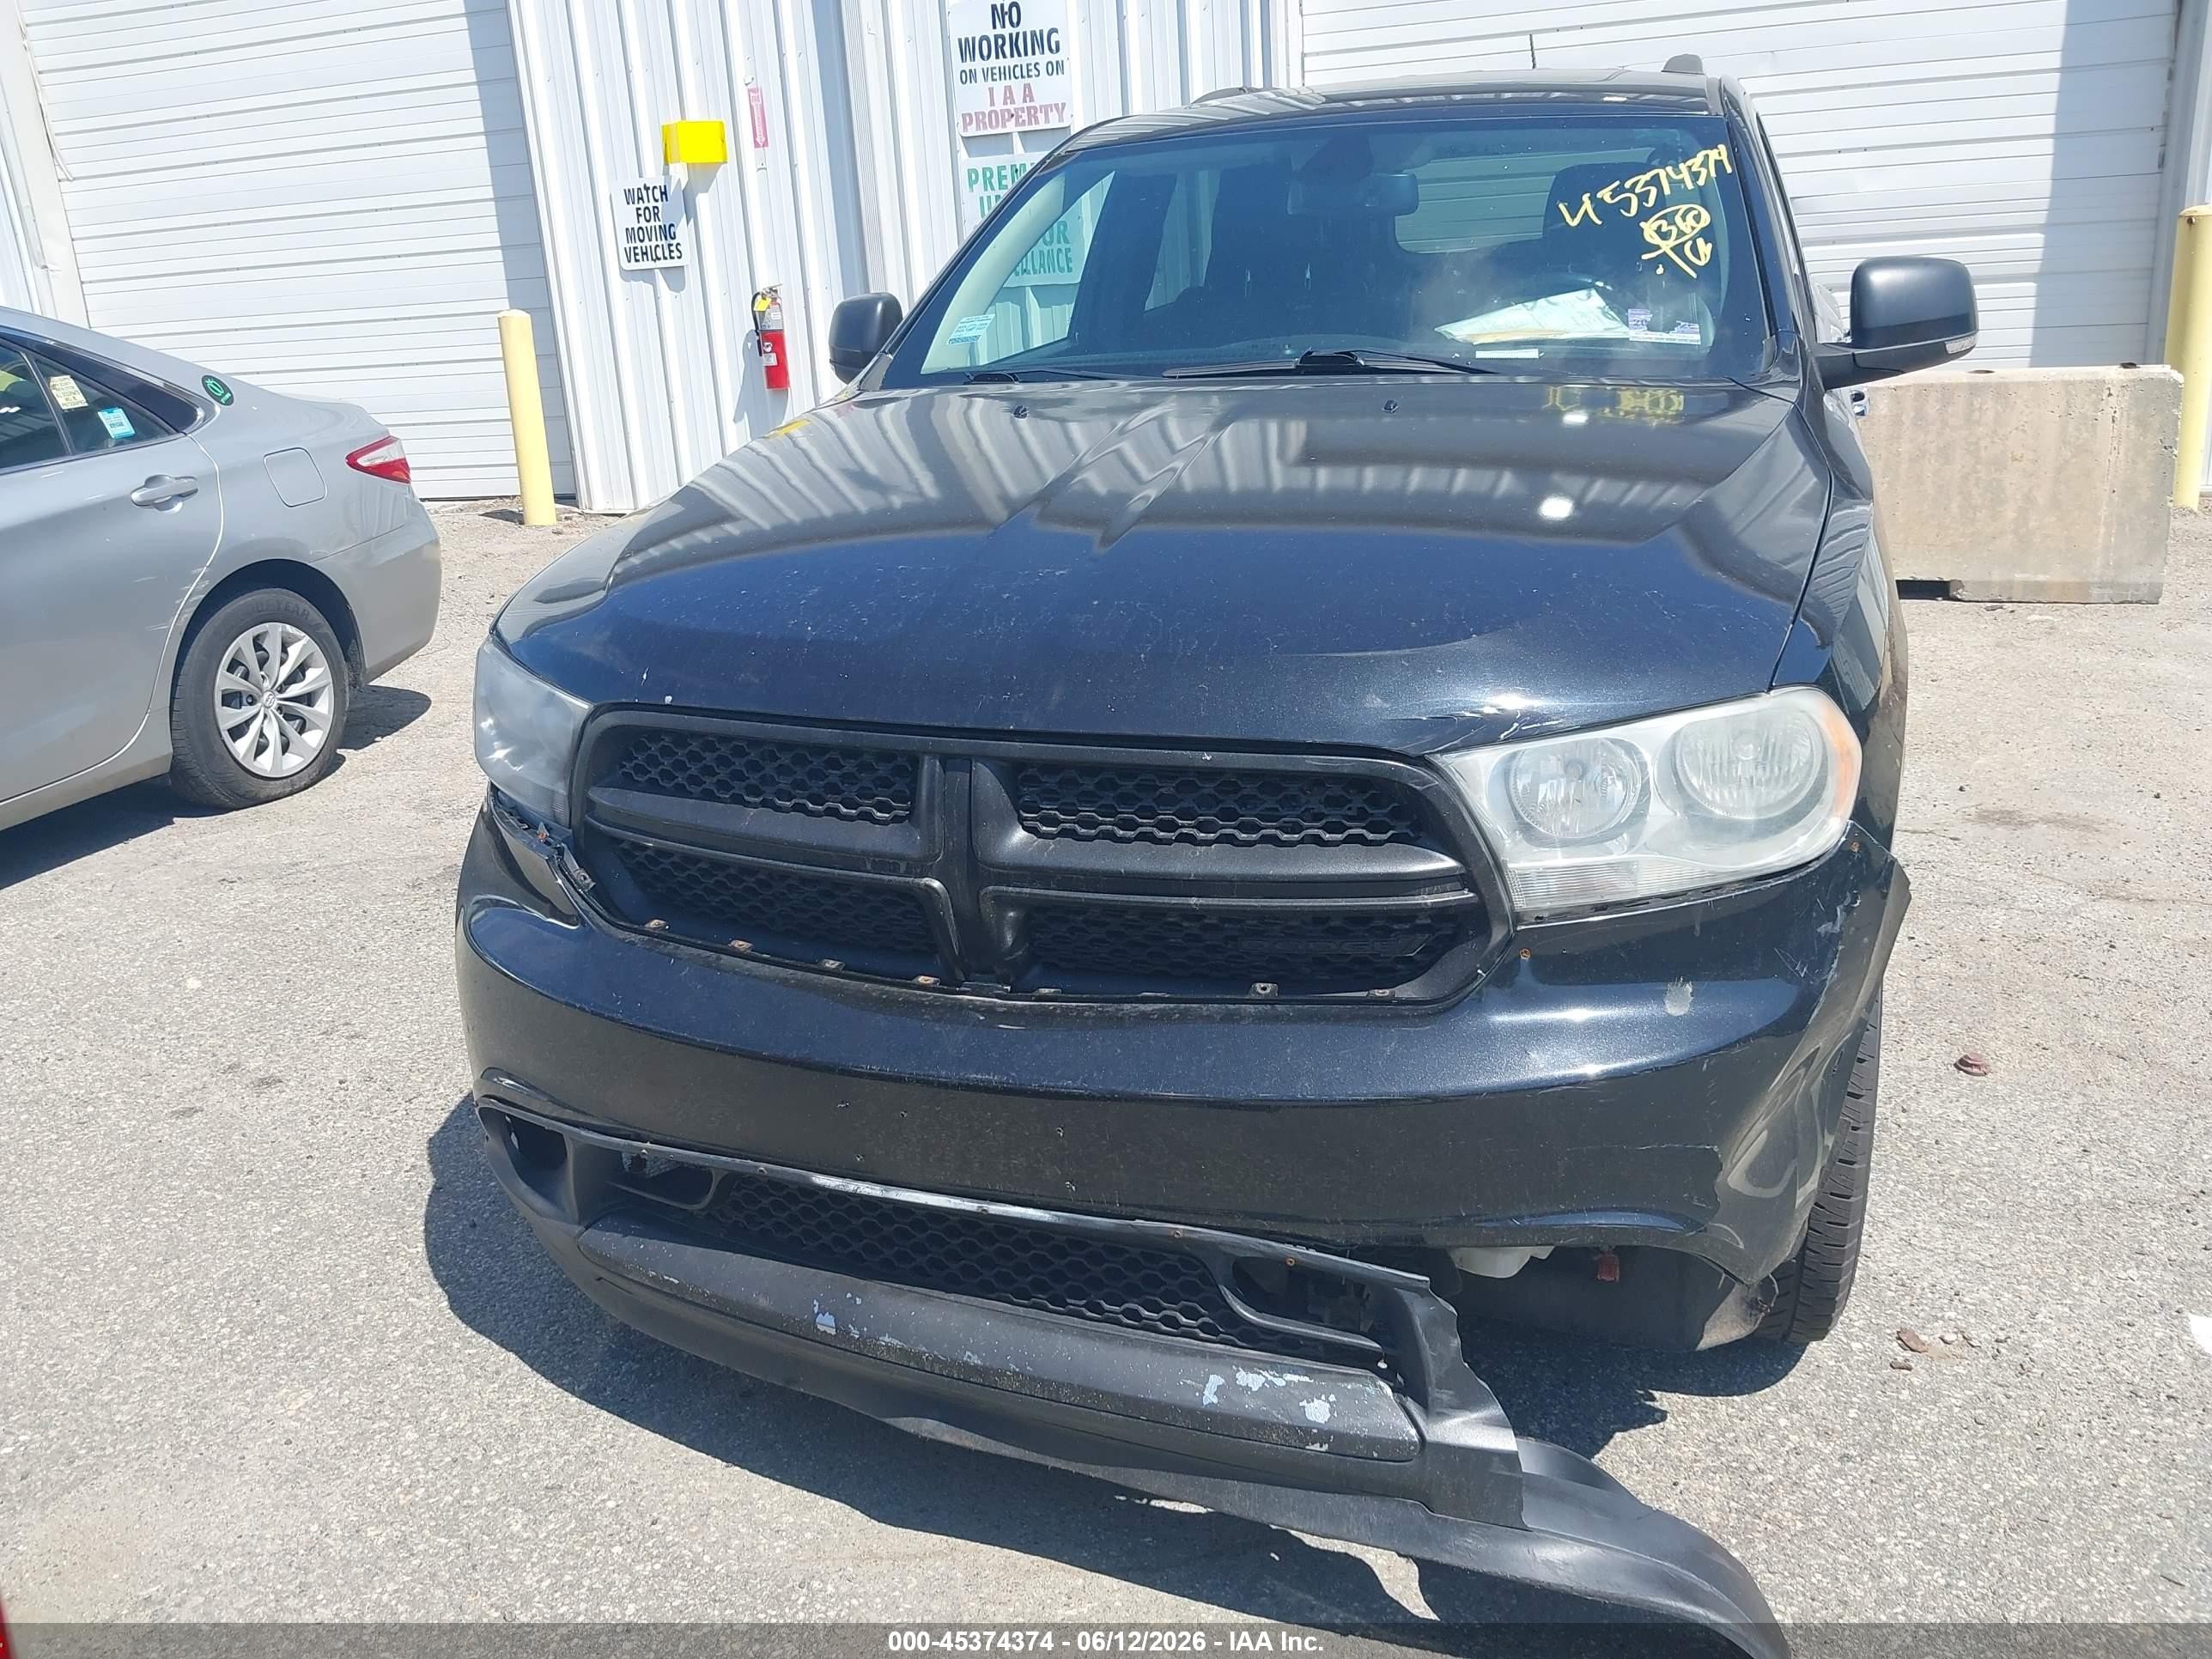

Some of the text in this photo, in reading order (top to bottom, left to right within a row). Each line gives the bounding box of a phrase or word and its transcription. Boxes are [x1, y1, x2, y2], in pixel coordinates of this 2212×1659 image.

[991, 1, 1021, 29] NO
[957, 27, 1060, 63] WORKING
[960, 60, 1065, 85] ON VEHICLES ON
[962, 102, 1066, 132] PROPERTY
[967, 162, 1036, 192] PREM
[623, 184, 669, 205] WATCH
[635, 206, 661, 223] FOR
[626, 223, 677, 244] MOVING
[624, 242, 683, 263] VEHICLES
